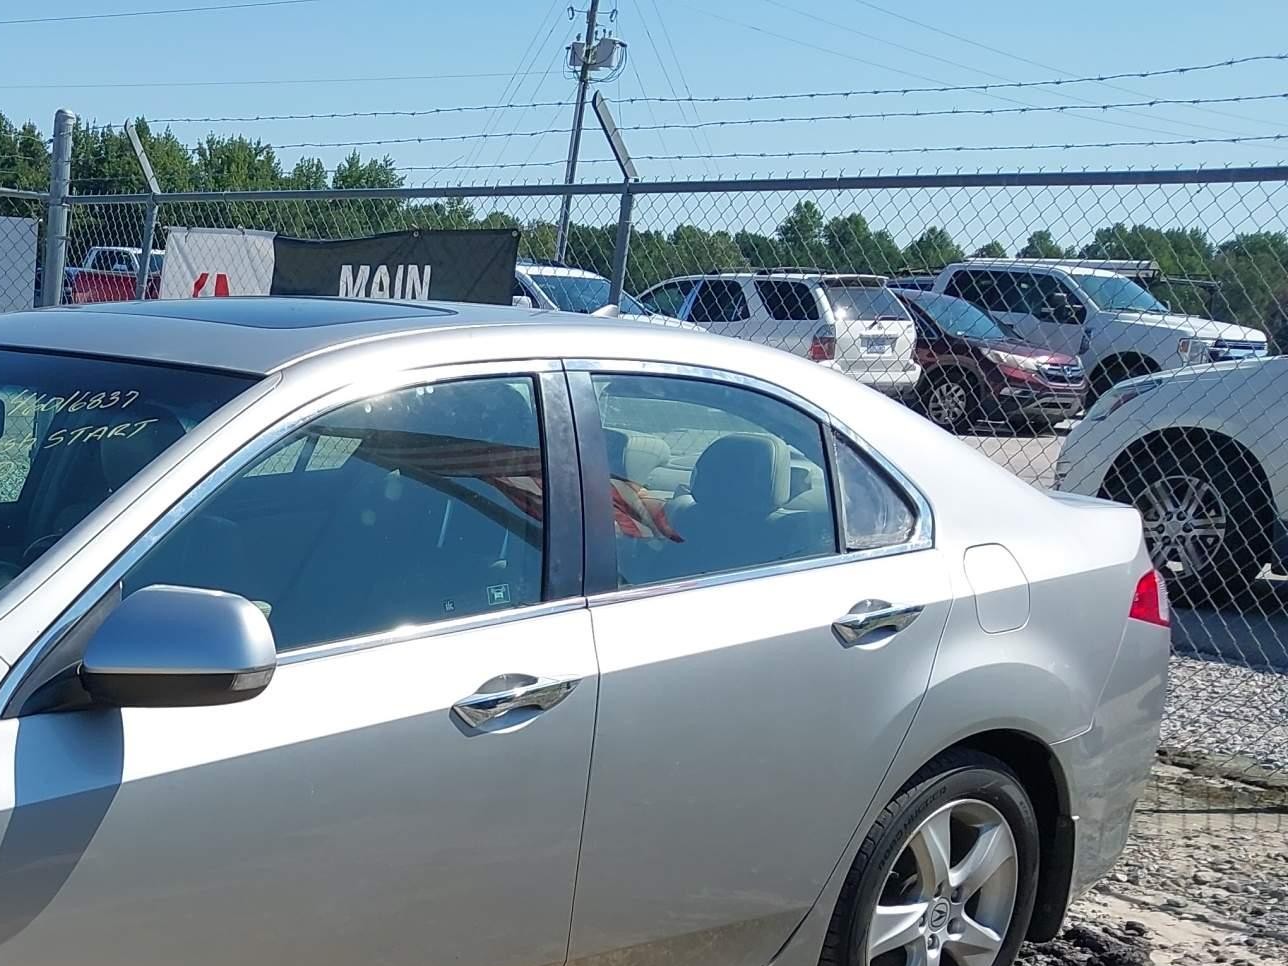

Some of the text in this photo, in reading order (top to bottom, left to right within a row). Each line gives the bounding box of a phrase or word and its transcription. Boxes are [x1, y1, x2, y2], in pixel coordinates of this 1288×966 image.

[338, 264, 432, 300] MAIN
[8, 388, 140, 416] 46016837
[45, 418, 159, 449] START
